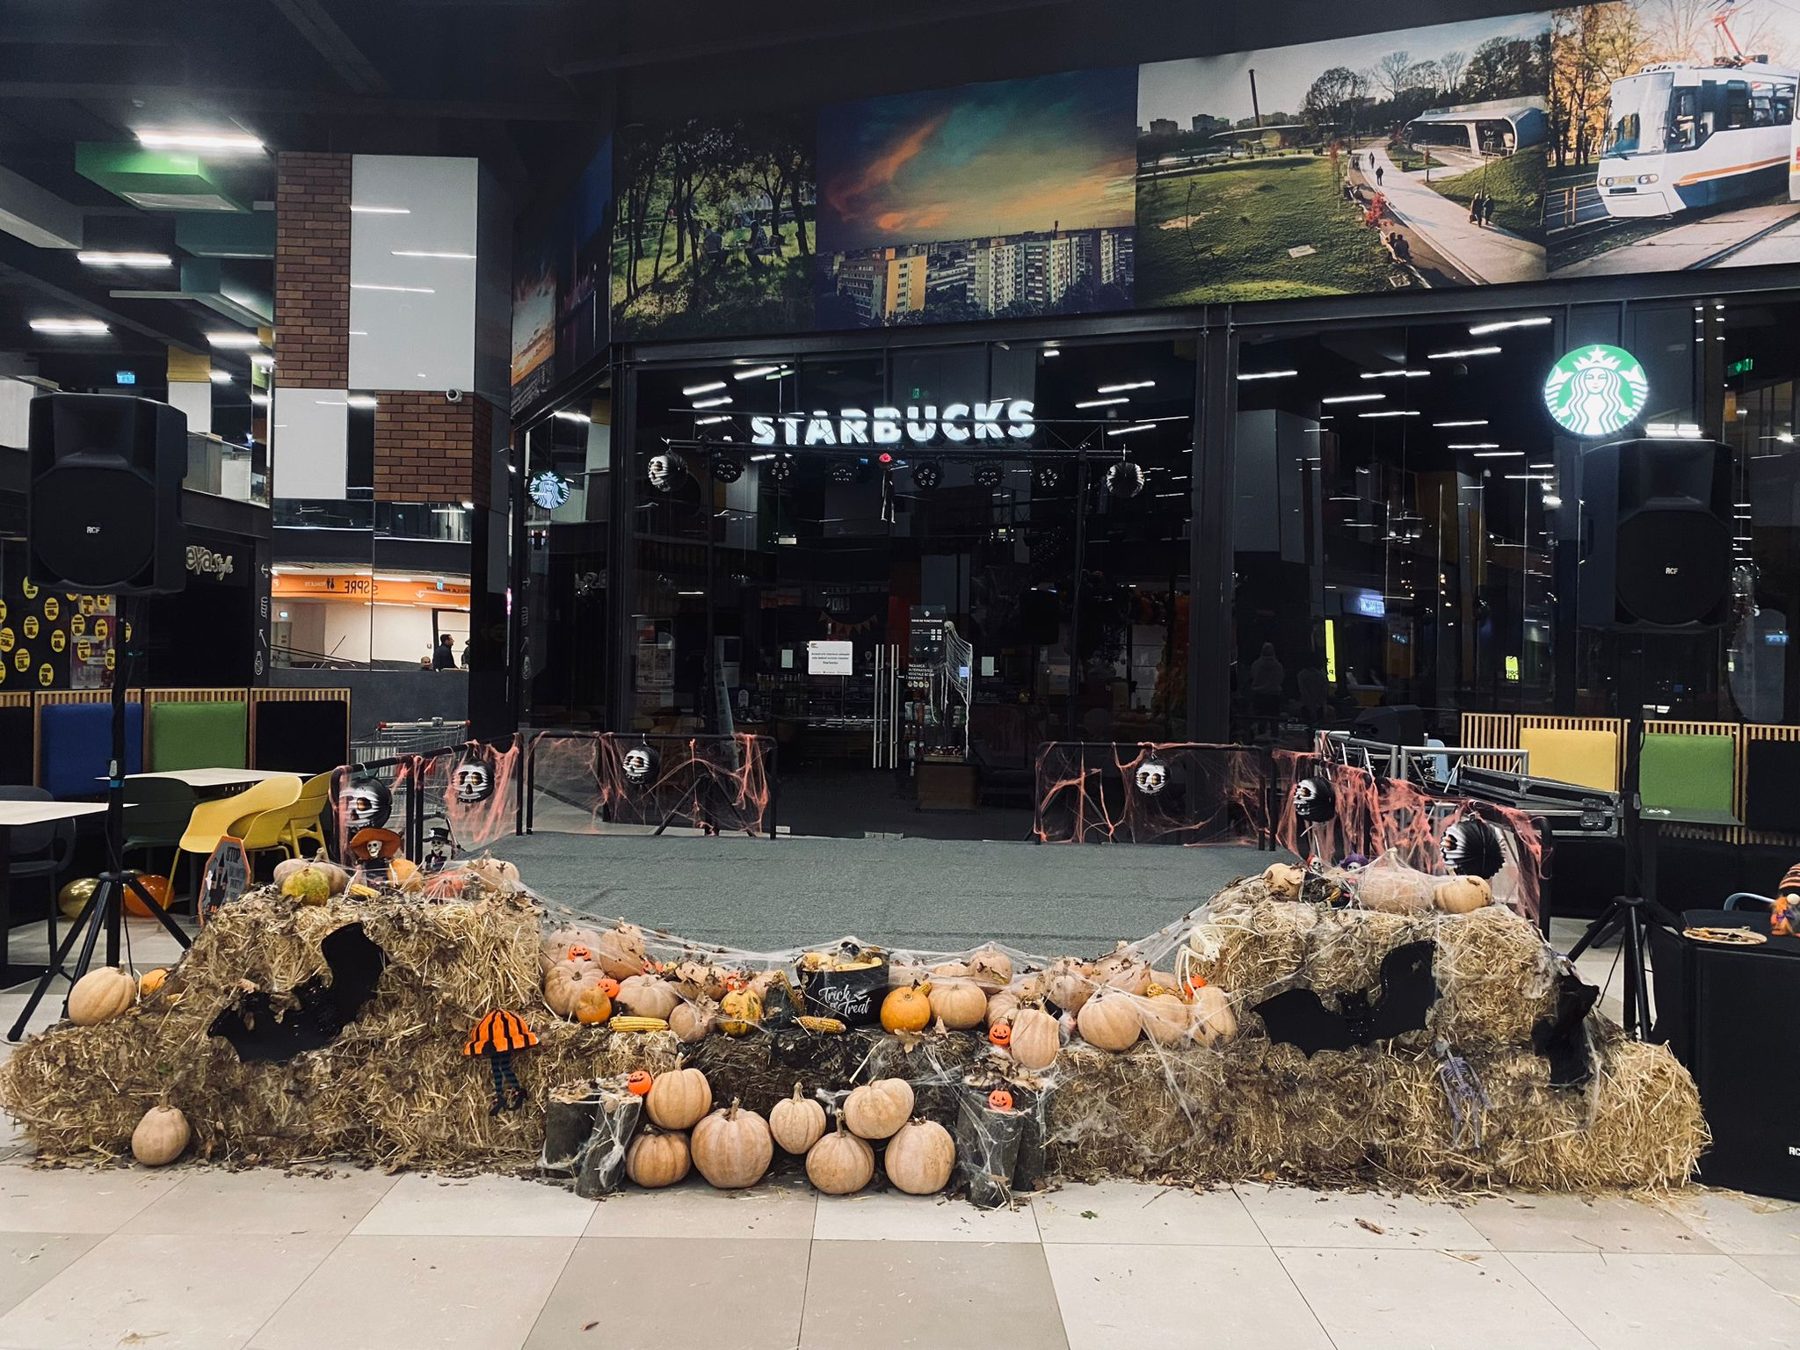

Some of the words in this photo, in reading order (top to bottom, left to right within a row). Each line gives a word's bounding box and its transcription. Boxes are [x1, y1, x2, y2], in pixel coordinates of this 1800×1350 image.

[751, 400, 1036, 446] STARBUCKS
[86, 526, 101, 534] RCF
[1665, 567, 1678, 575] RCF
[818, 984, 851, 1003] Trick
[837, 997, 872, 1017] Treat
